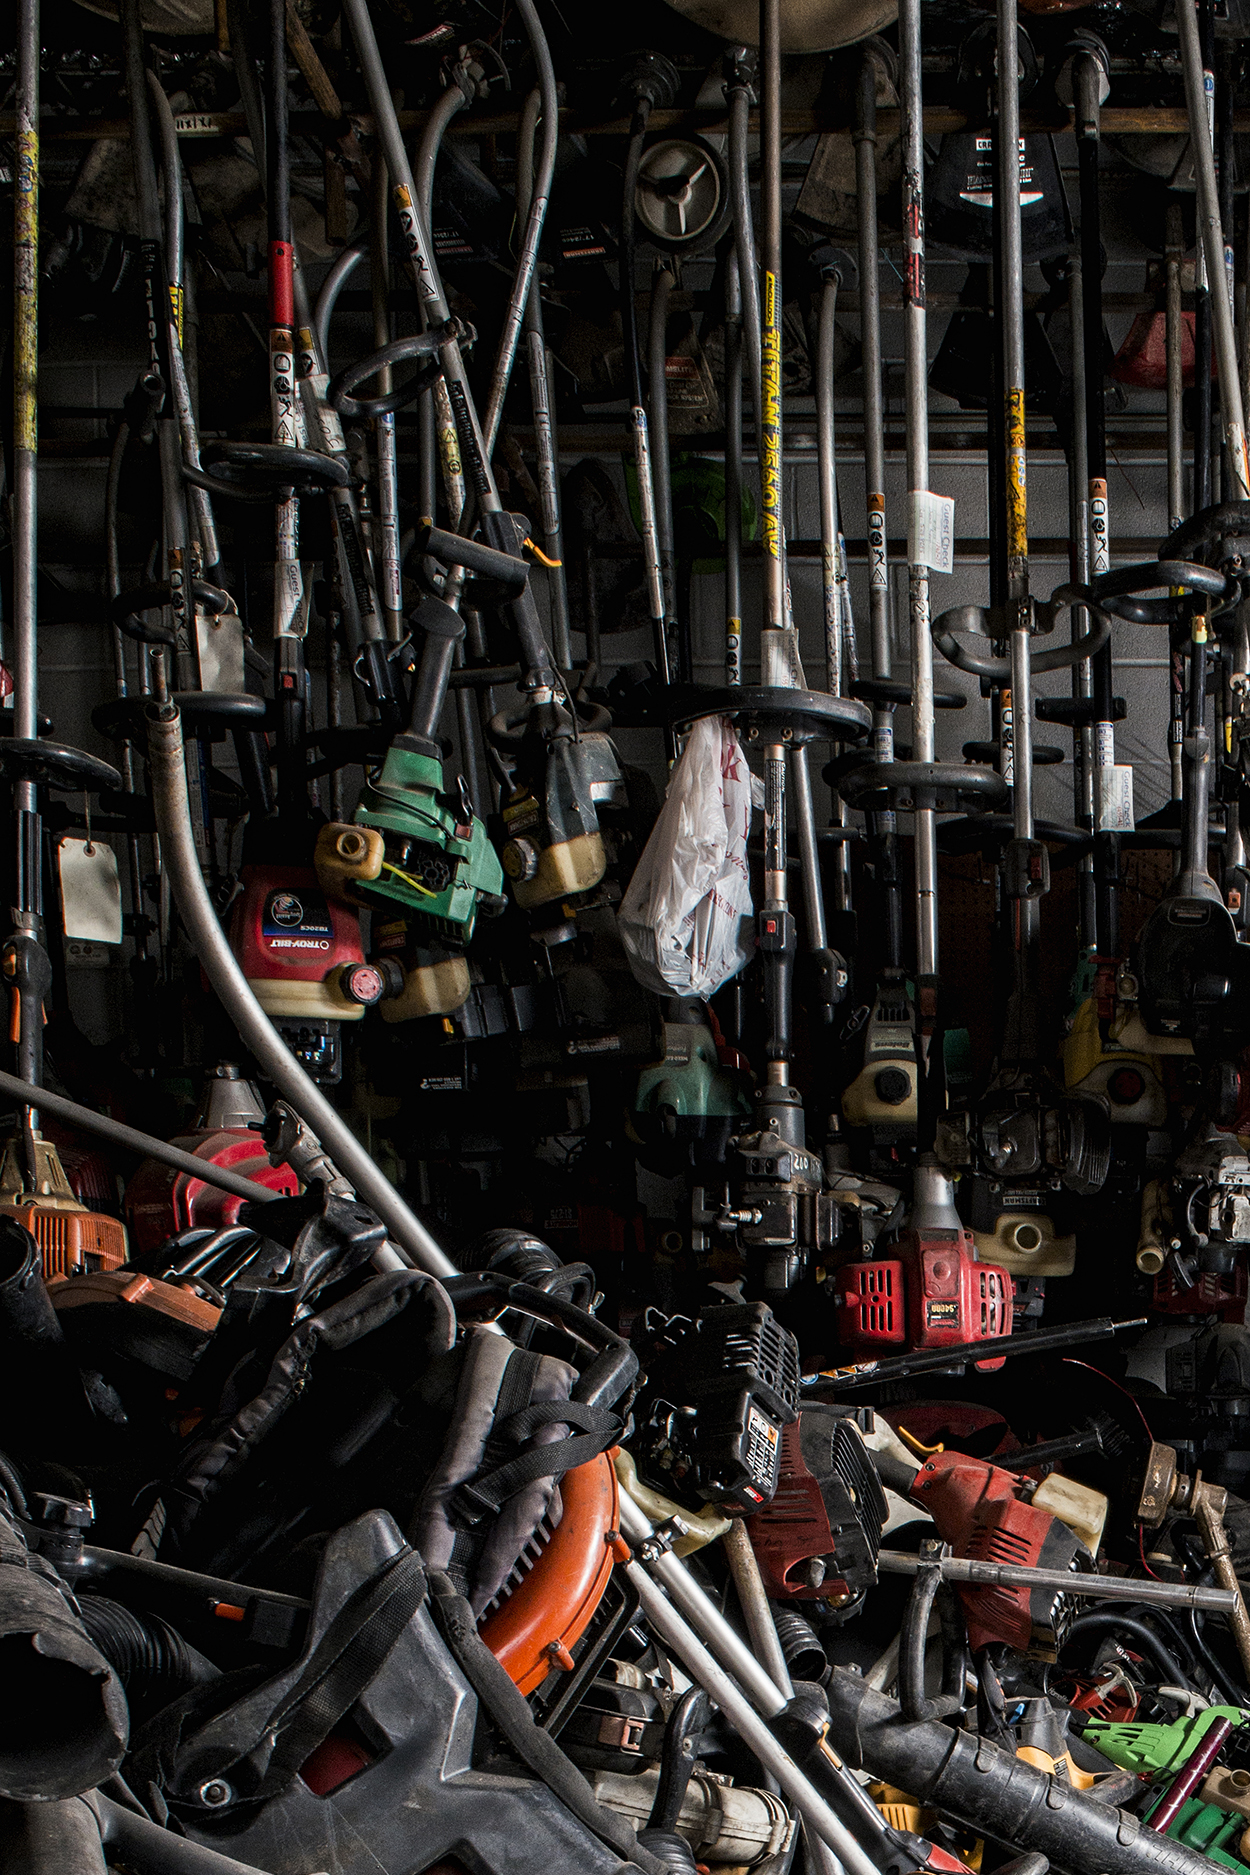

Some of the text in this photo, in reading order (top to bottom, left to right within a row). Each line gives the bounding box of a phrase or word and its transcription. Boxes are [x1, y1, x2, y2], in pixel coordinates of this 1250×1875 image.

[761, 328, 781, 426] TITAN
[761, 432, 780, 508] 2560
[942, 503, 952, 568] Guest Check
[289, 565, 300, 597] Guest
[789, 634, 799, 690] Guest Che
[1123, 771, 1132, 827] Guest Check
[269, 939, 320, 950] TROY-BILT
